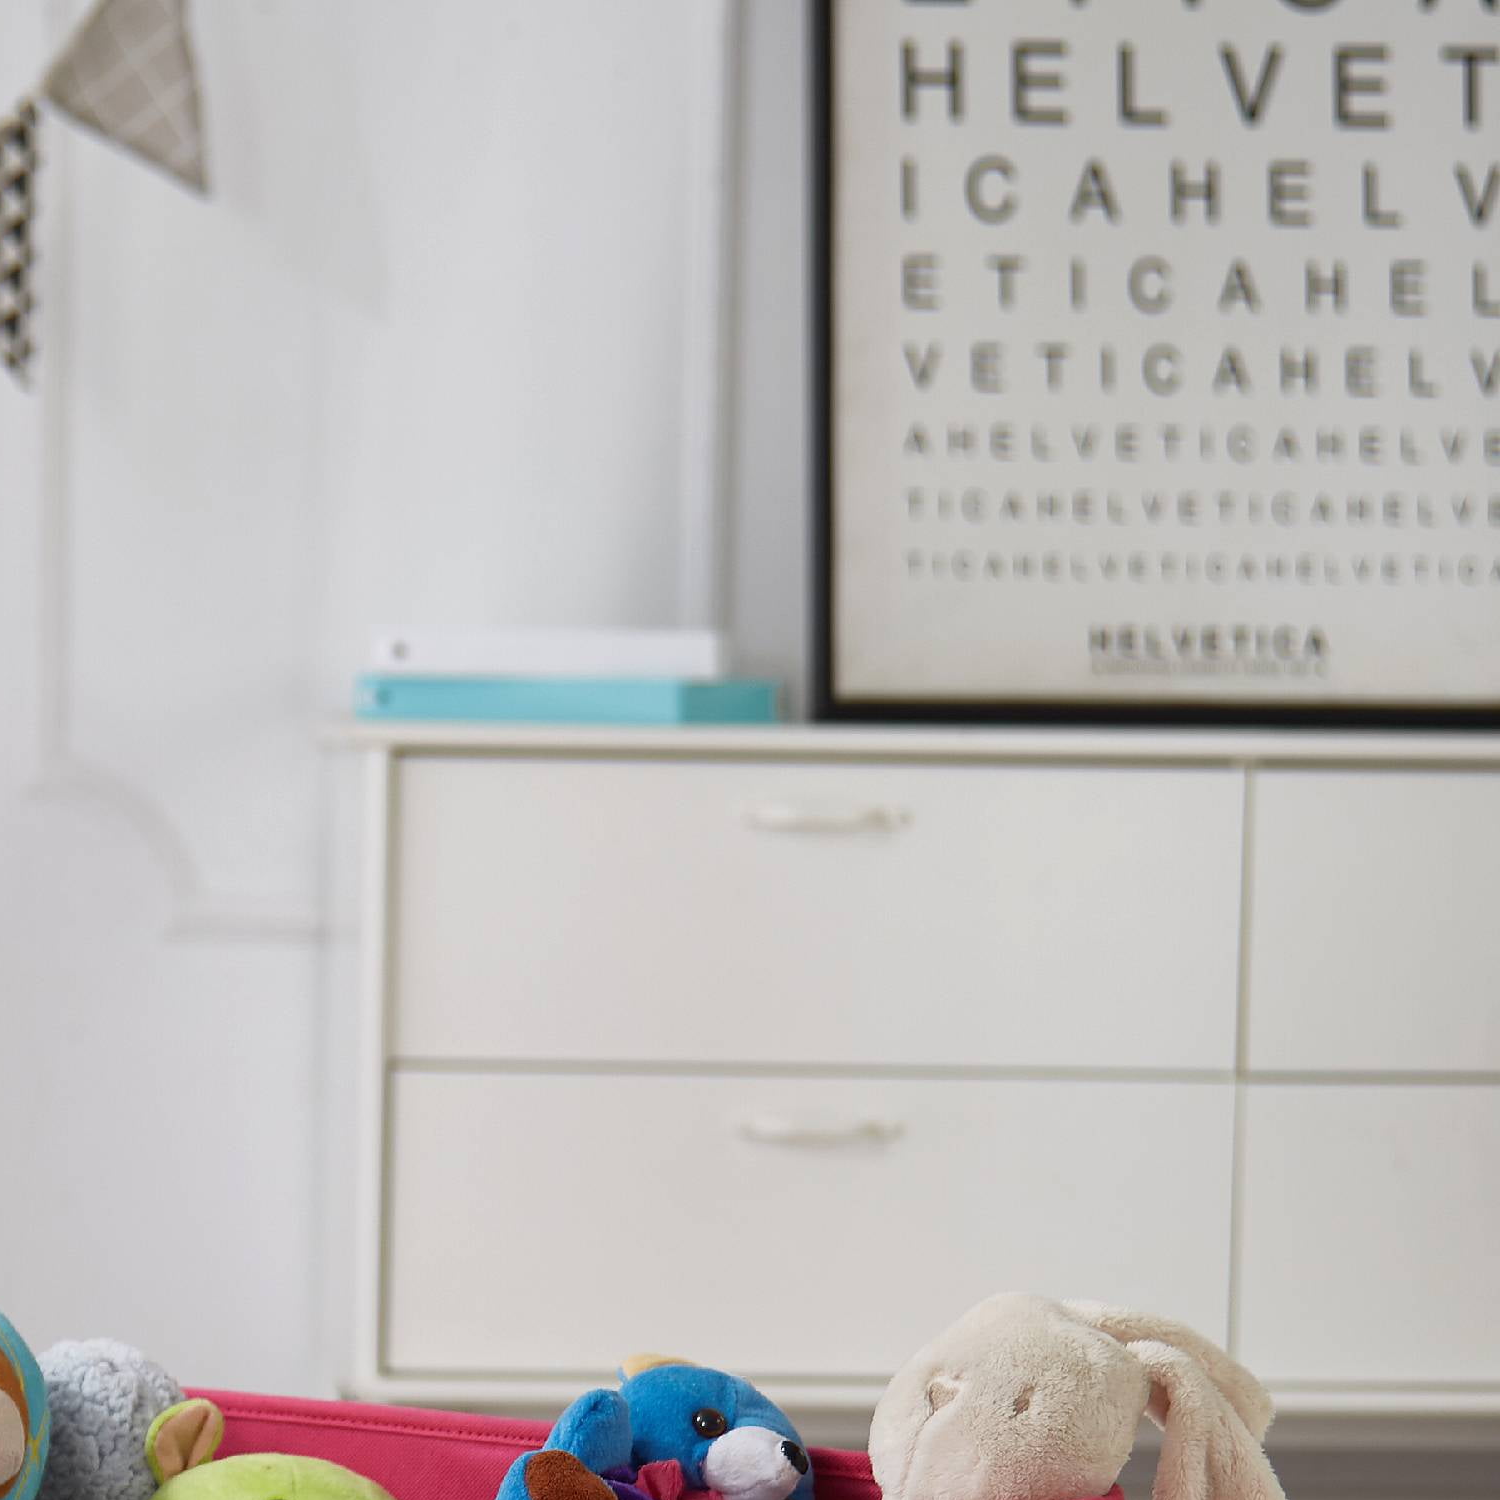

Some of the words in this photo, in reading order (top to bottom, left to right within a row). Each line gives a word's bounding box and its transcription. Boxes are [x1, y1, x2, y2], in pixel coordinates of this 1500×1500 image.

[901, 155, 1500, 228] ICAHELV
[901, 253, 1500, 317] ETICAHEL
[1088, 624, 1328, 661] HELVETICA
